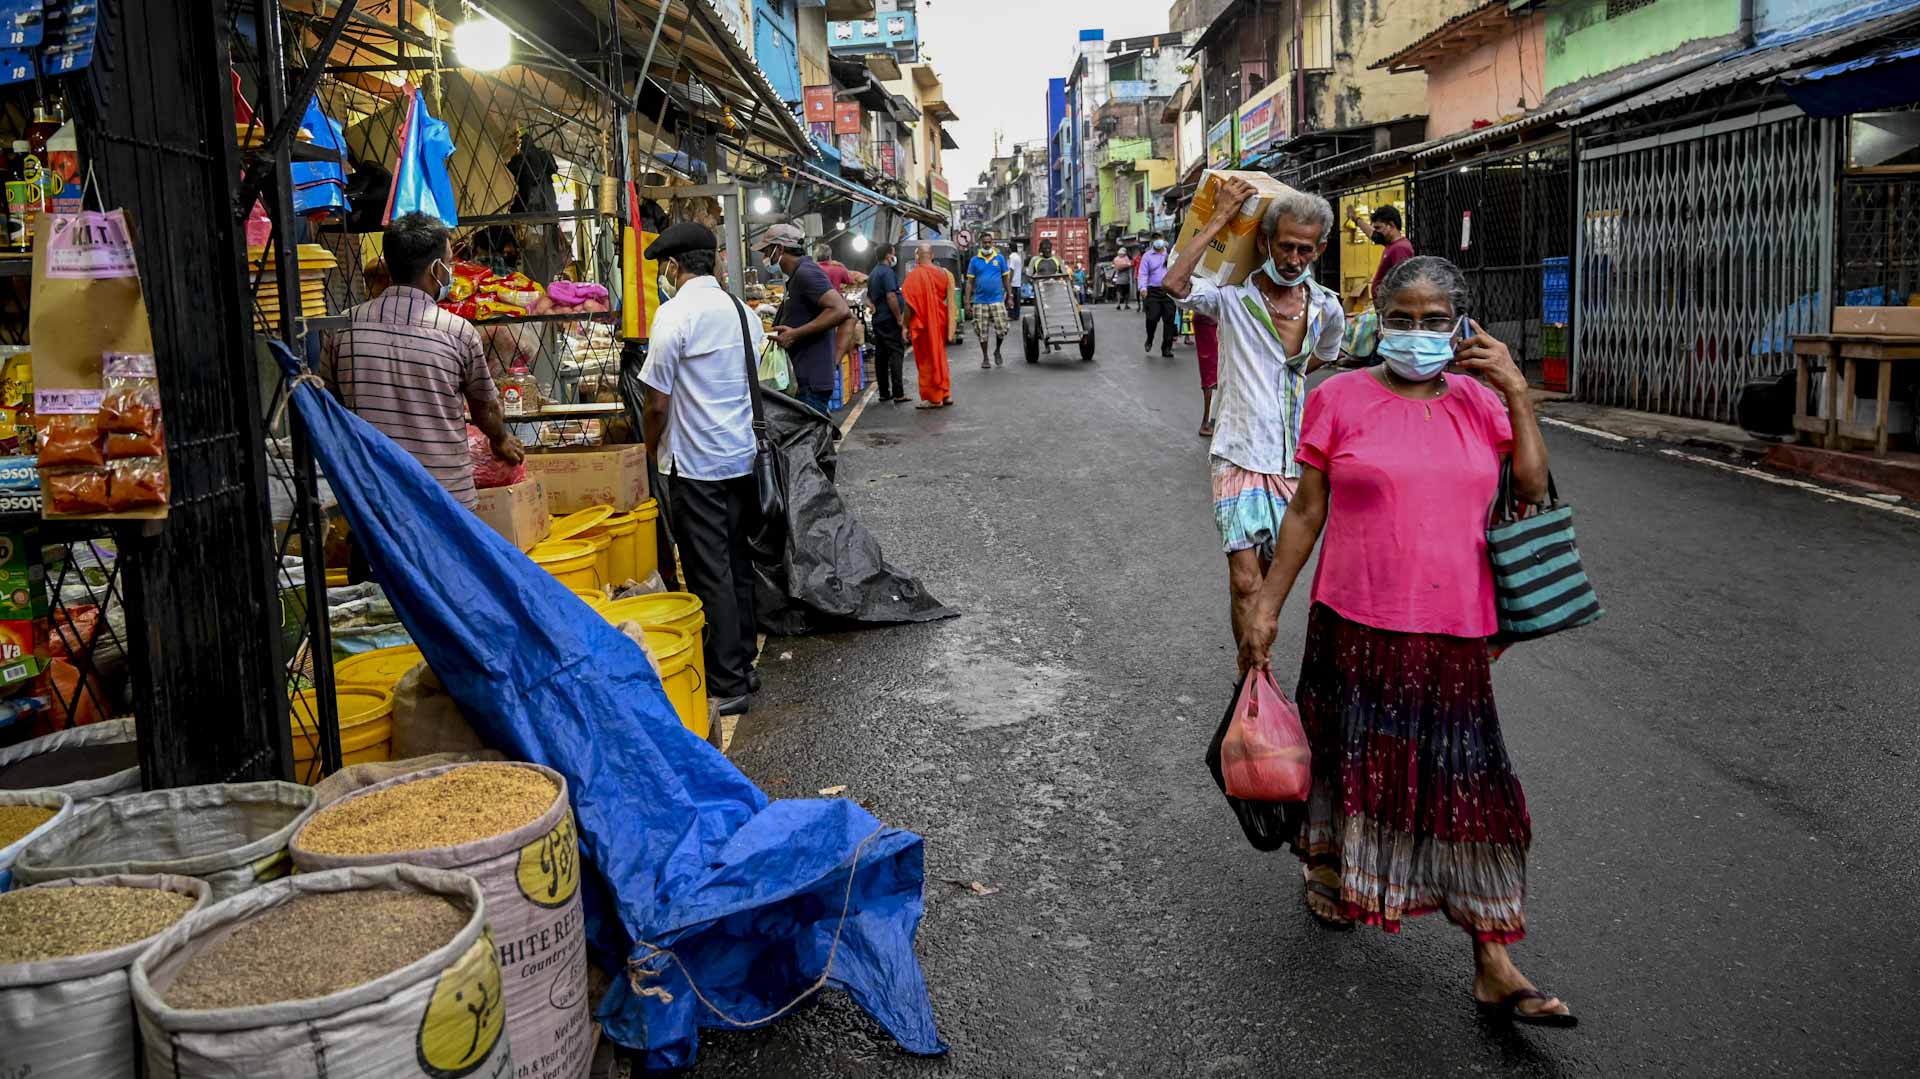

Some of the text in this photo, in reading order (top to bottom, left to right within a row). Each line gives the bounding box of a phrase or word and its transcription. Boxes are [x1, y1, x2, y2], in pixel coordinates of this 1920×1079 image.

[10, 31, 24, 44] 18
[60, 56, 74, 70] 18
[12, 66, 26, 80] 18
[521, 946, 567, 978] Country
